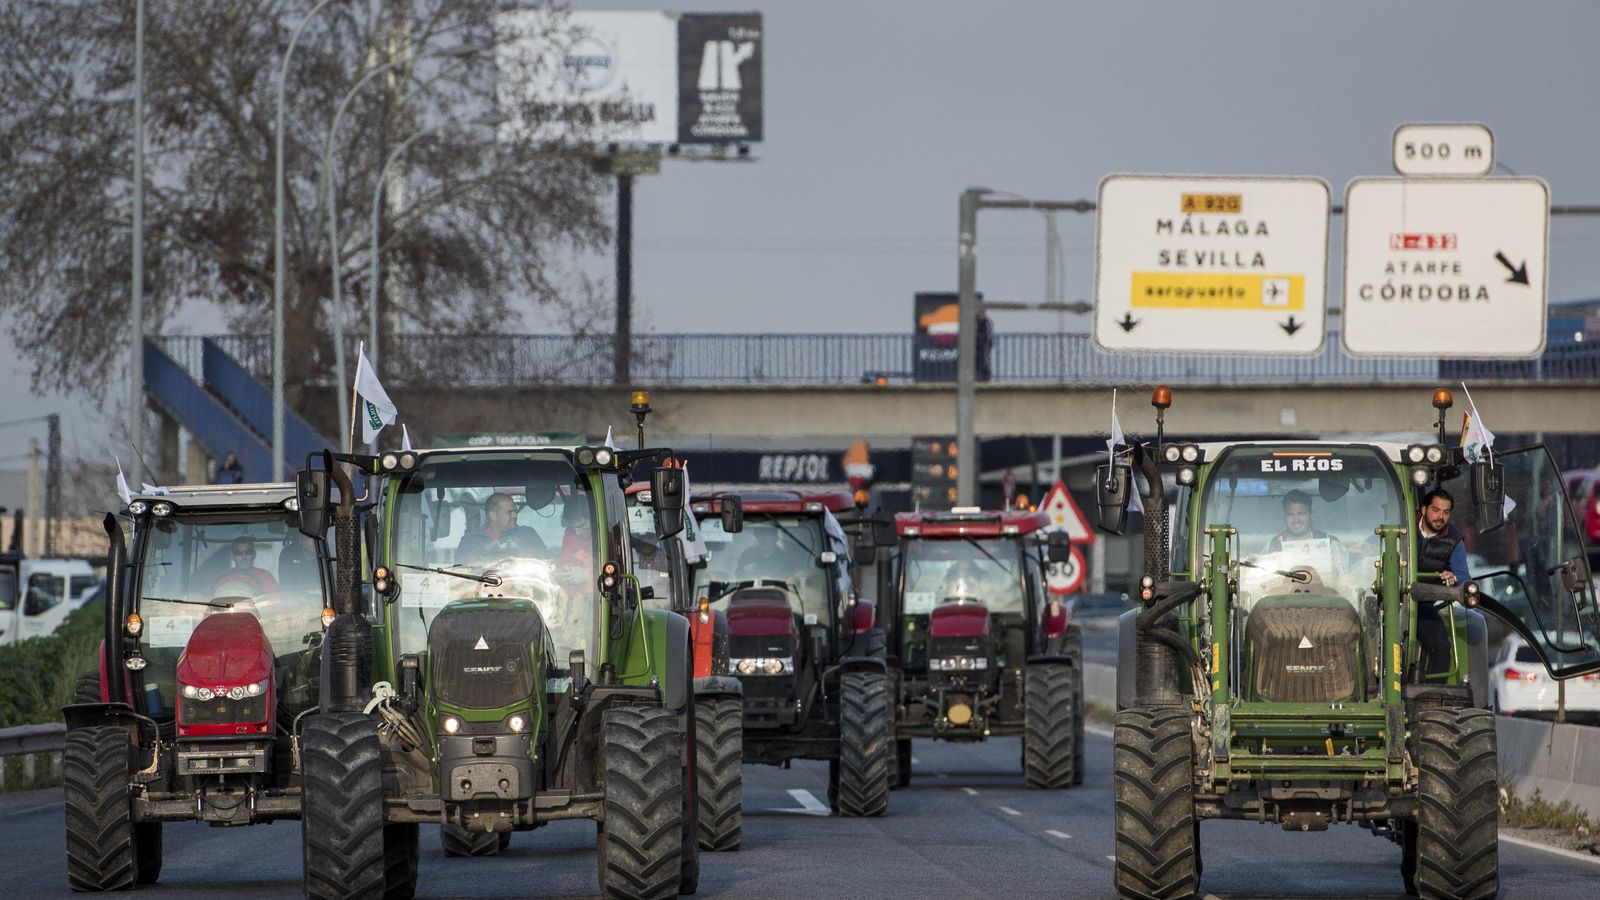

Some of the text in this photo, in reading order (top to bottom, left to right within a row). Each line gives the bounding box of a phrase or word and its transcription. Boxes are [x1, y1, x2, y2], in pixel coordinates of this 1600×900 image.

[1405, 142, 1482, 159] 500 m
[1156, 212, 1269, 235] MÁLAGA
[1159, 249, 1266, 267] SEVILLA
[1385, 261, 1461, 273] ATARFE
[1145, 285, 1246, 300] aeropuerto
[1360, 278, 1490, 300] CÓRDOBA
[759, 454, 829, 481] REPSOL
[1261, 456, 1344, 473] EL RÍOS
[166, 619, 176, 631] 4
